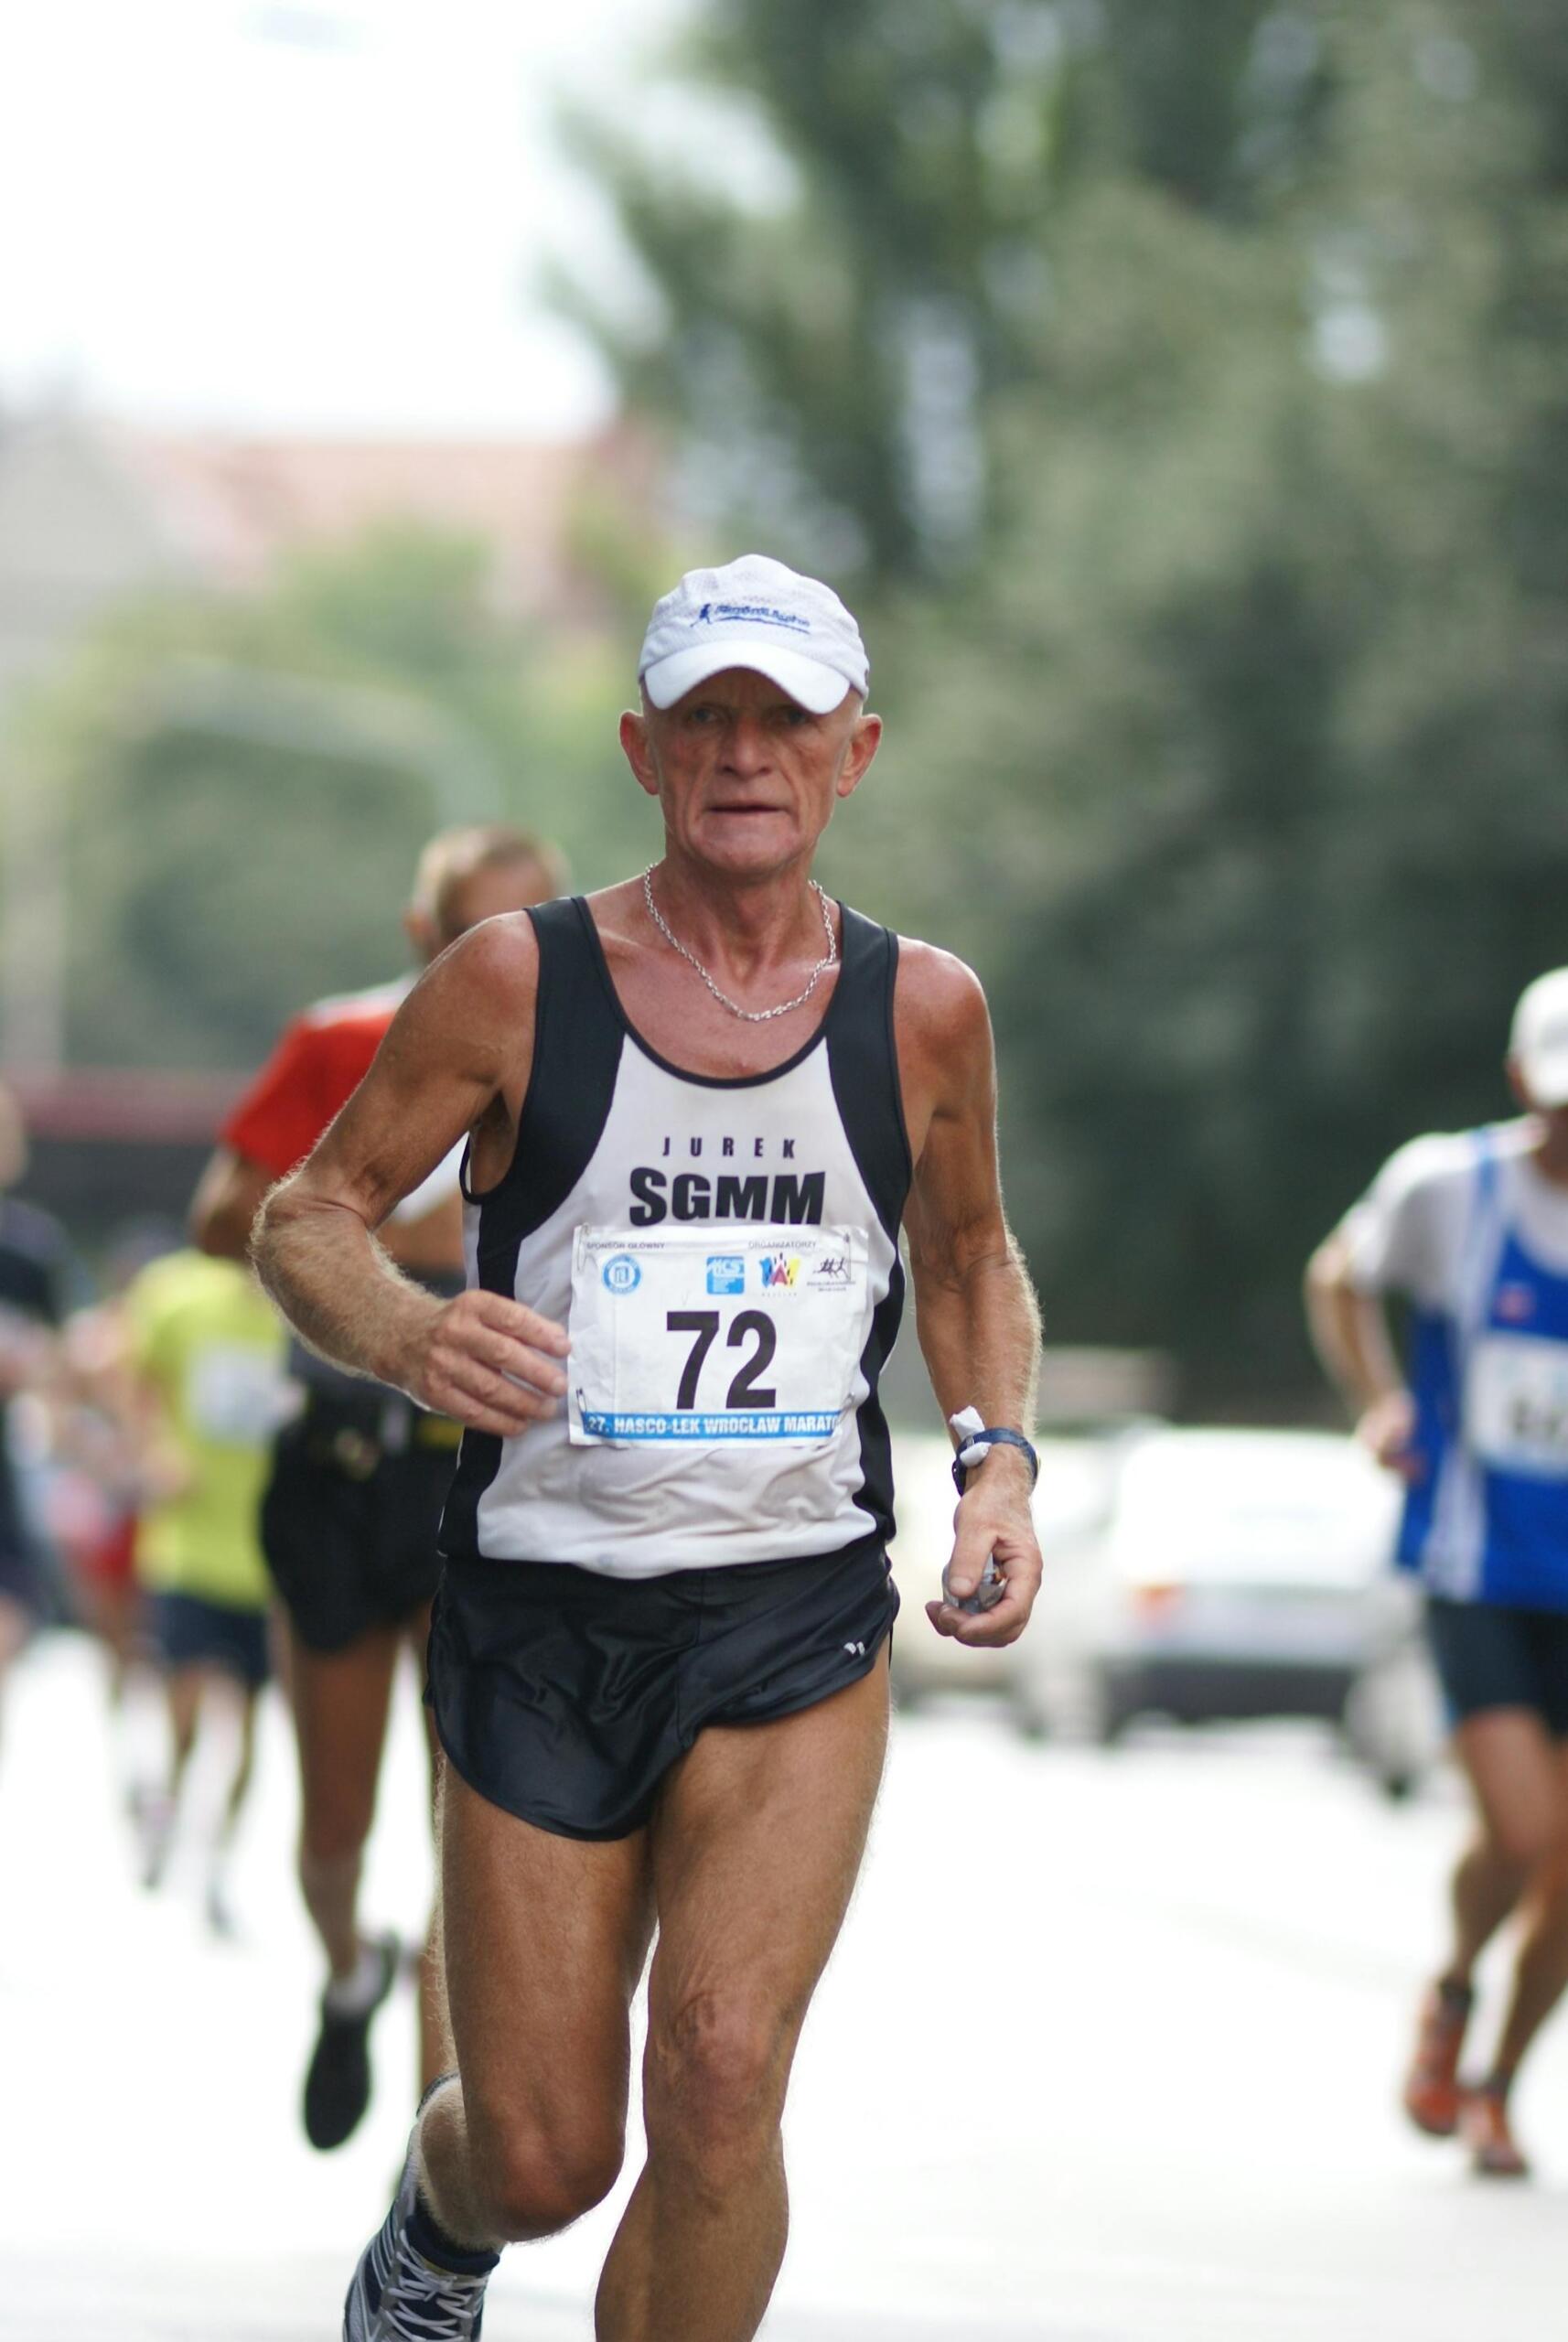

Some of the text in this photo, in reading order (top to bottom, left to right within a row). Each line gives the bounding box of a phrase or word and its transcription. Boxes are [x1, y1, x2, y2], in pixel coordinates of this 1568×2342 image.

[662, 1137, 795, 1159] JUREK
[629, 1166, 826, 1227] SGMM
[666, 1310, 777, 1410] 72
[614, 1417, 700, 1434] HASCO-LEK
